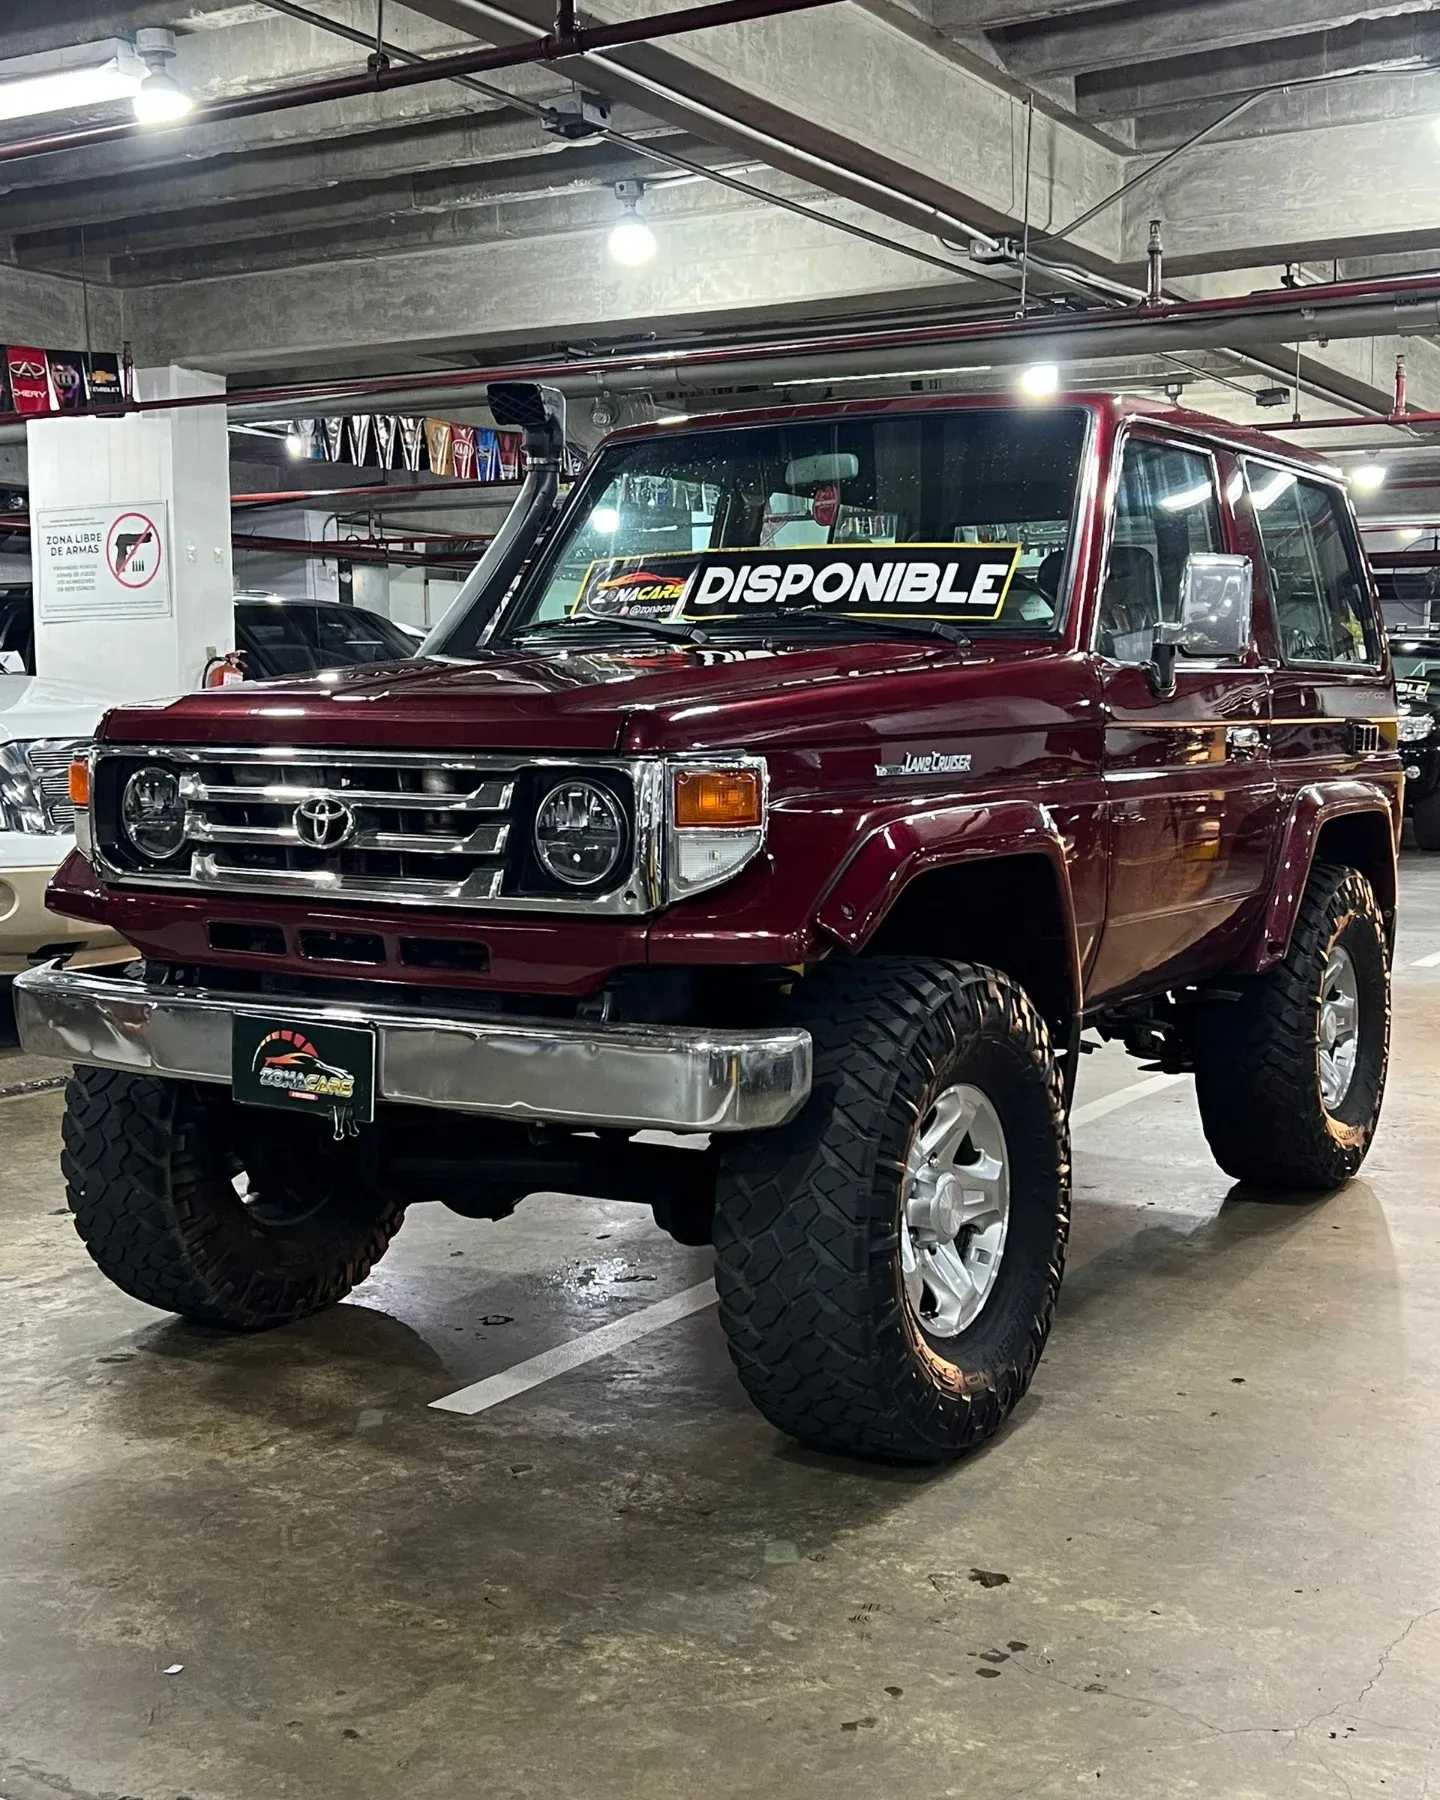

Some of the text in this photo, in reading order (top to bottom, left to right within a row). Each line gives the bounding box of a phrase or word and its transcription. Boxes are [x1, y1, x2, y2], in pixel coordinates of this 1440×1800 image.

[13, 388, 47, 399] CHERY
[46, 532, 102, 545] ZONA LIBRE
[51, 544, 99, 556] DE ARMAS
[695, 562, 1009, 605] DISPONIBLE
[591, 584, 685, 605] ZONACARS
[629, 605, 675, 616] @zonacar
[259, 1066, 355, 1098] ZONACARS
